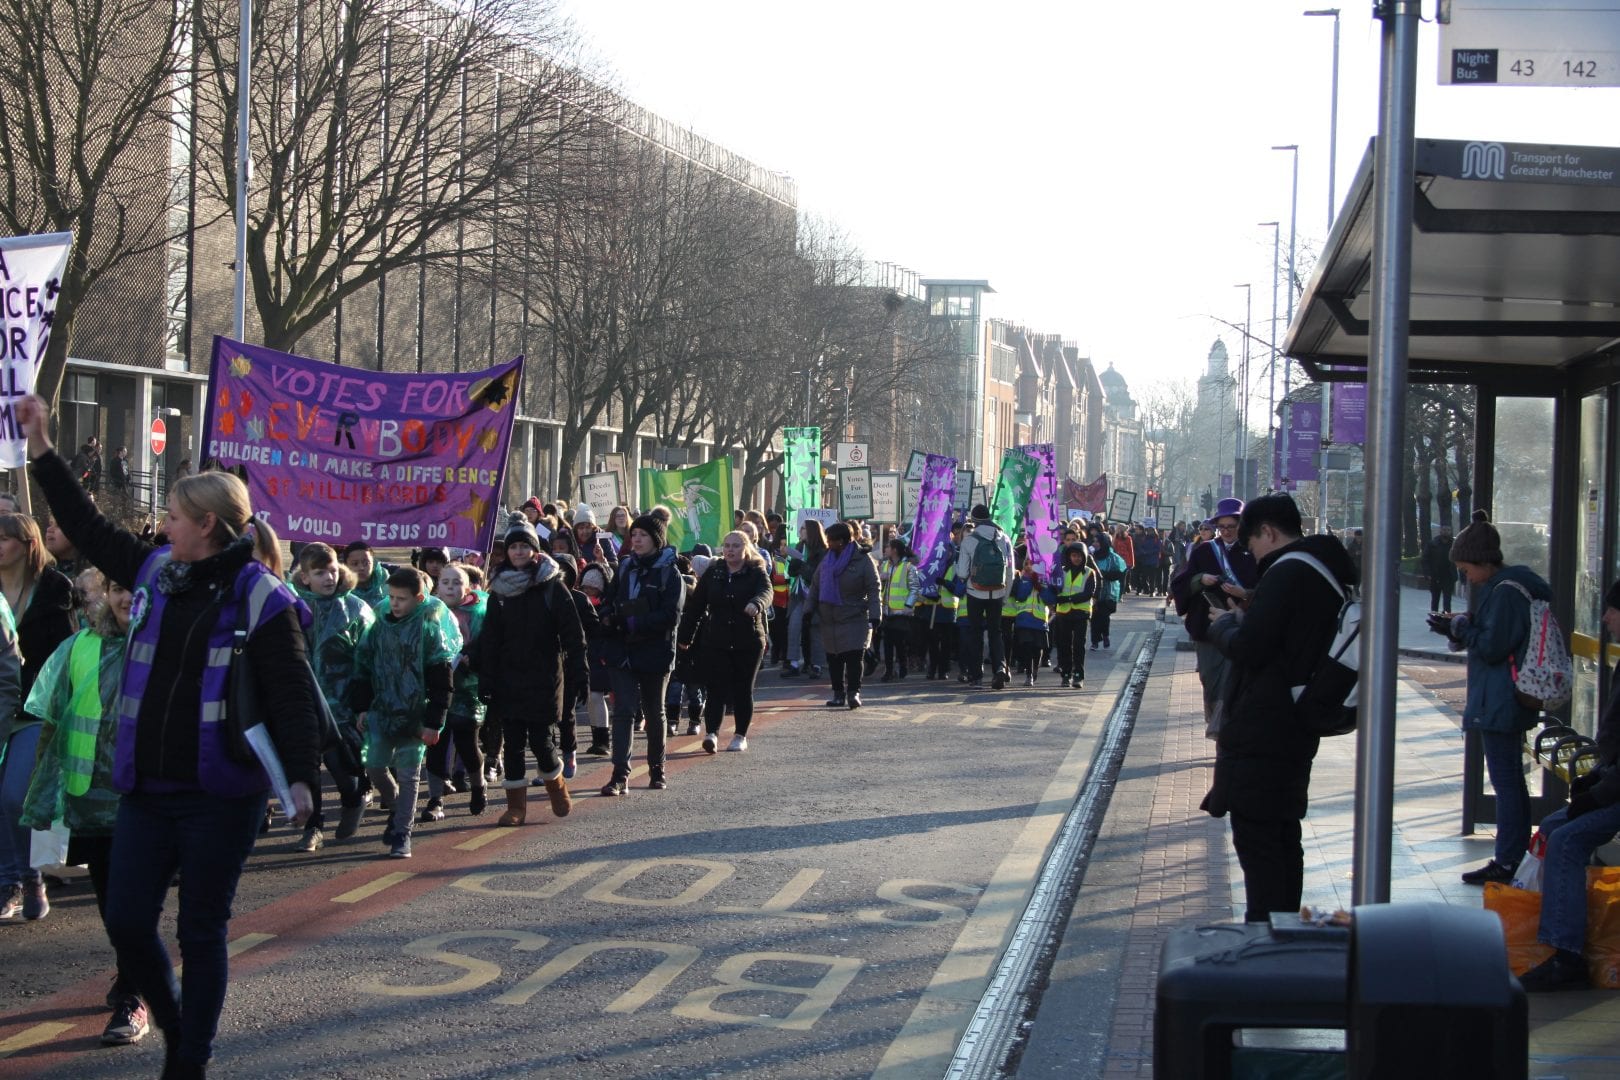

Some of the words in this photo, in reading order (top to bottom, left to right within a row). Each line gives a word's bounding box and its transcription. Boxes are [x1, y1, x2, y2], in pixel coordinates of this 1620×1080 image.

[1456, 52, 1490, 67] Night
[1456, 67, 1479, 80] Bus
[1510, 60, 1535, 76] 43
[1563, 61, 1597, 78] 142
[1511, 152, 1562, 166] Transport
[1564, 154, 1581, 164] for
[1510, 165, 1550, 177] Greater
[1552, 166, 1615, 179] Manchester
[271, 364, 388, 412] VOTES
[400, 379, 471, 415] FOR
[268, 399, 476, 460] EVERYBODY
[208, 439, 283, 466] CHILDREN
[288, 450, 318, 470] CAN
[323, 457, 374, 479] MAKE
[380, 464, 390, 480] A
[396, 465, 498, 487] DIFFERENCE
[266, 476, 292, 497] ST
[589, 482, 611, 491] Deeds
[846, 475, 864, 483] Votes
[594, 491, 608, 499] Not
[590, 500, 613, 509] Words
[804, 510, 831, 518] VOTES
[288, 514, 342, 537] WOULD
[361, 522, 420, 541] JESUS
[451, 857, 984, 927] STOP
[355, 928, 866, 1030] BUS
